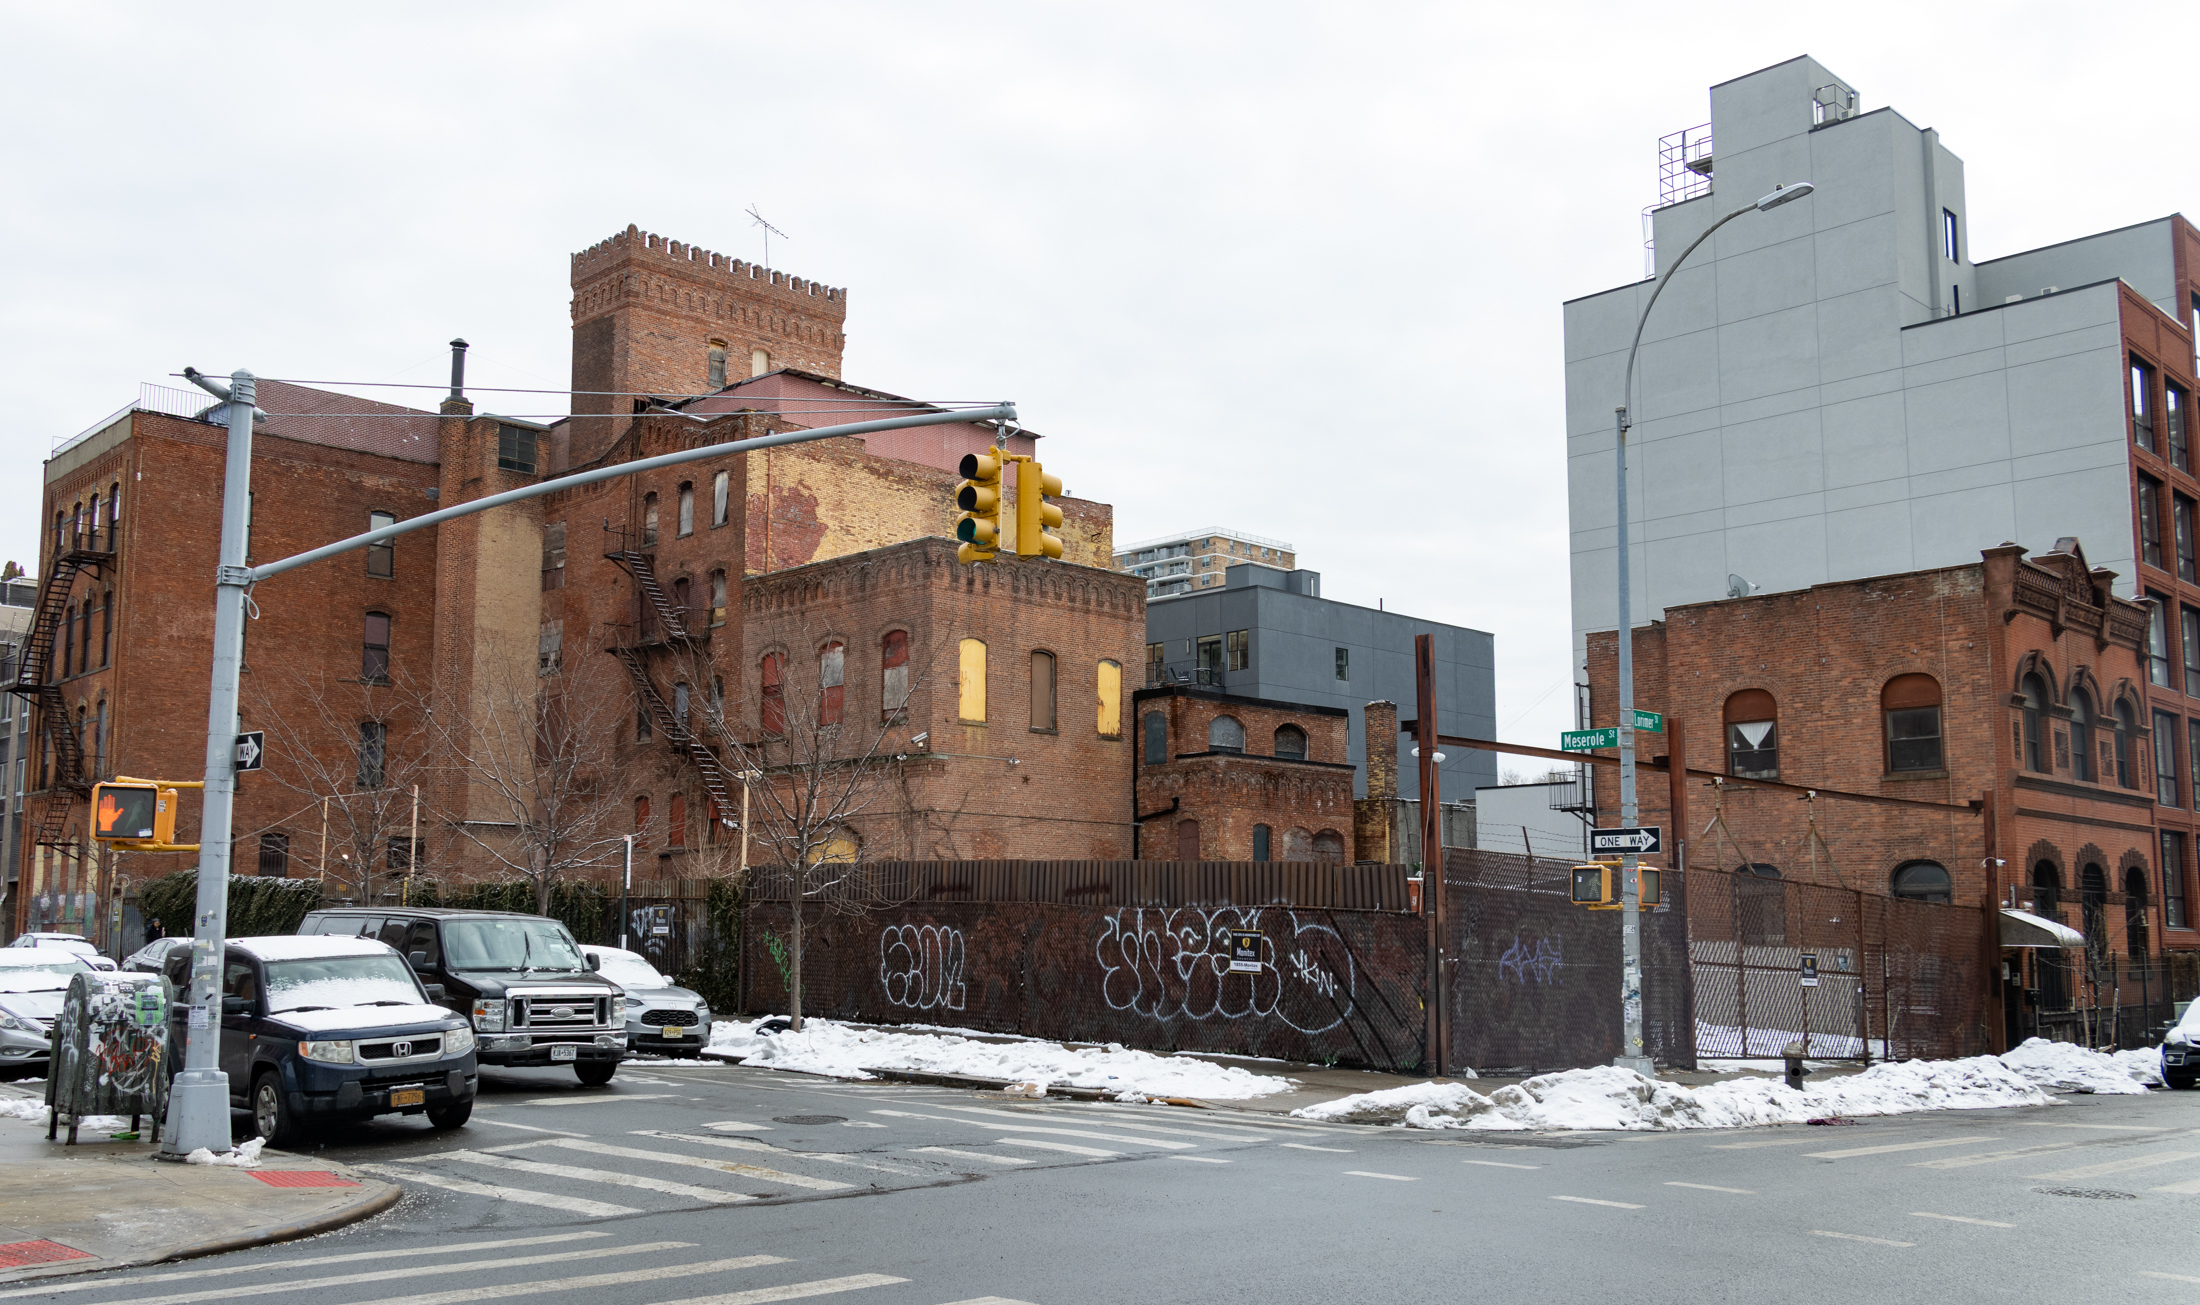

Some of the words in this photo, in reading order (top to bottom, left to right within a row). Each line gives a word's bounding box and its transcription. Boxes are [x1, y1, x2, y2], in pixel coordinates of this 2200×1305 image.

[1634, 713, 1654, 729] Lorimer
[1564, 732, 1605, 748] Meserole
[1608, 729, 1615, 739] St
[240, 744, 255, 760] WAY
[1600, 836, 1620, 847] ONE
[1629, 835, 1650, 846] WAY
[1236, 946, 1256, 957] Monitex
